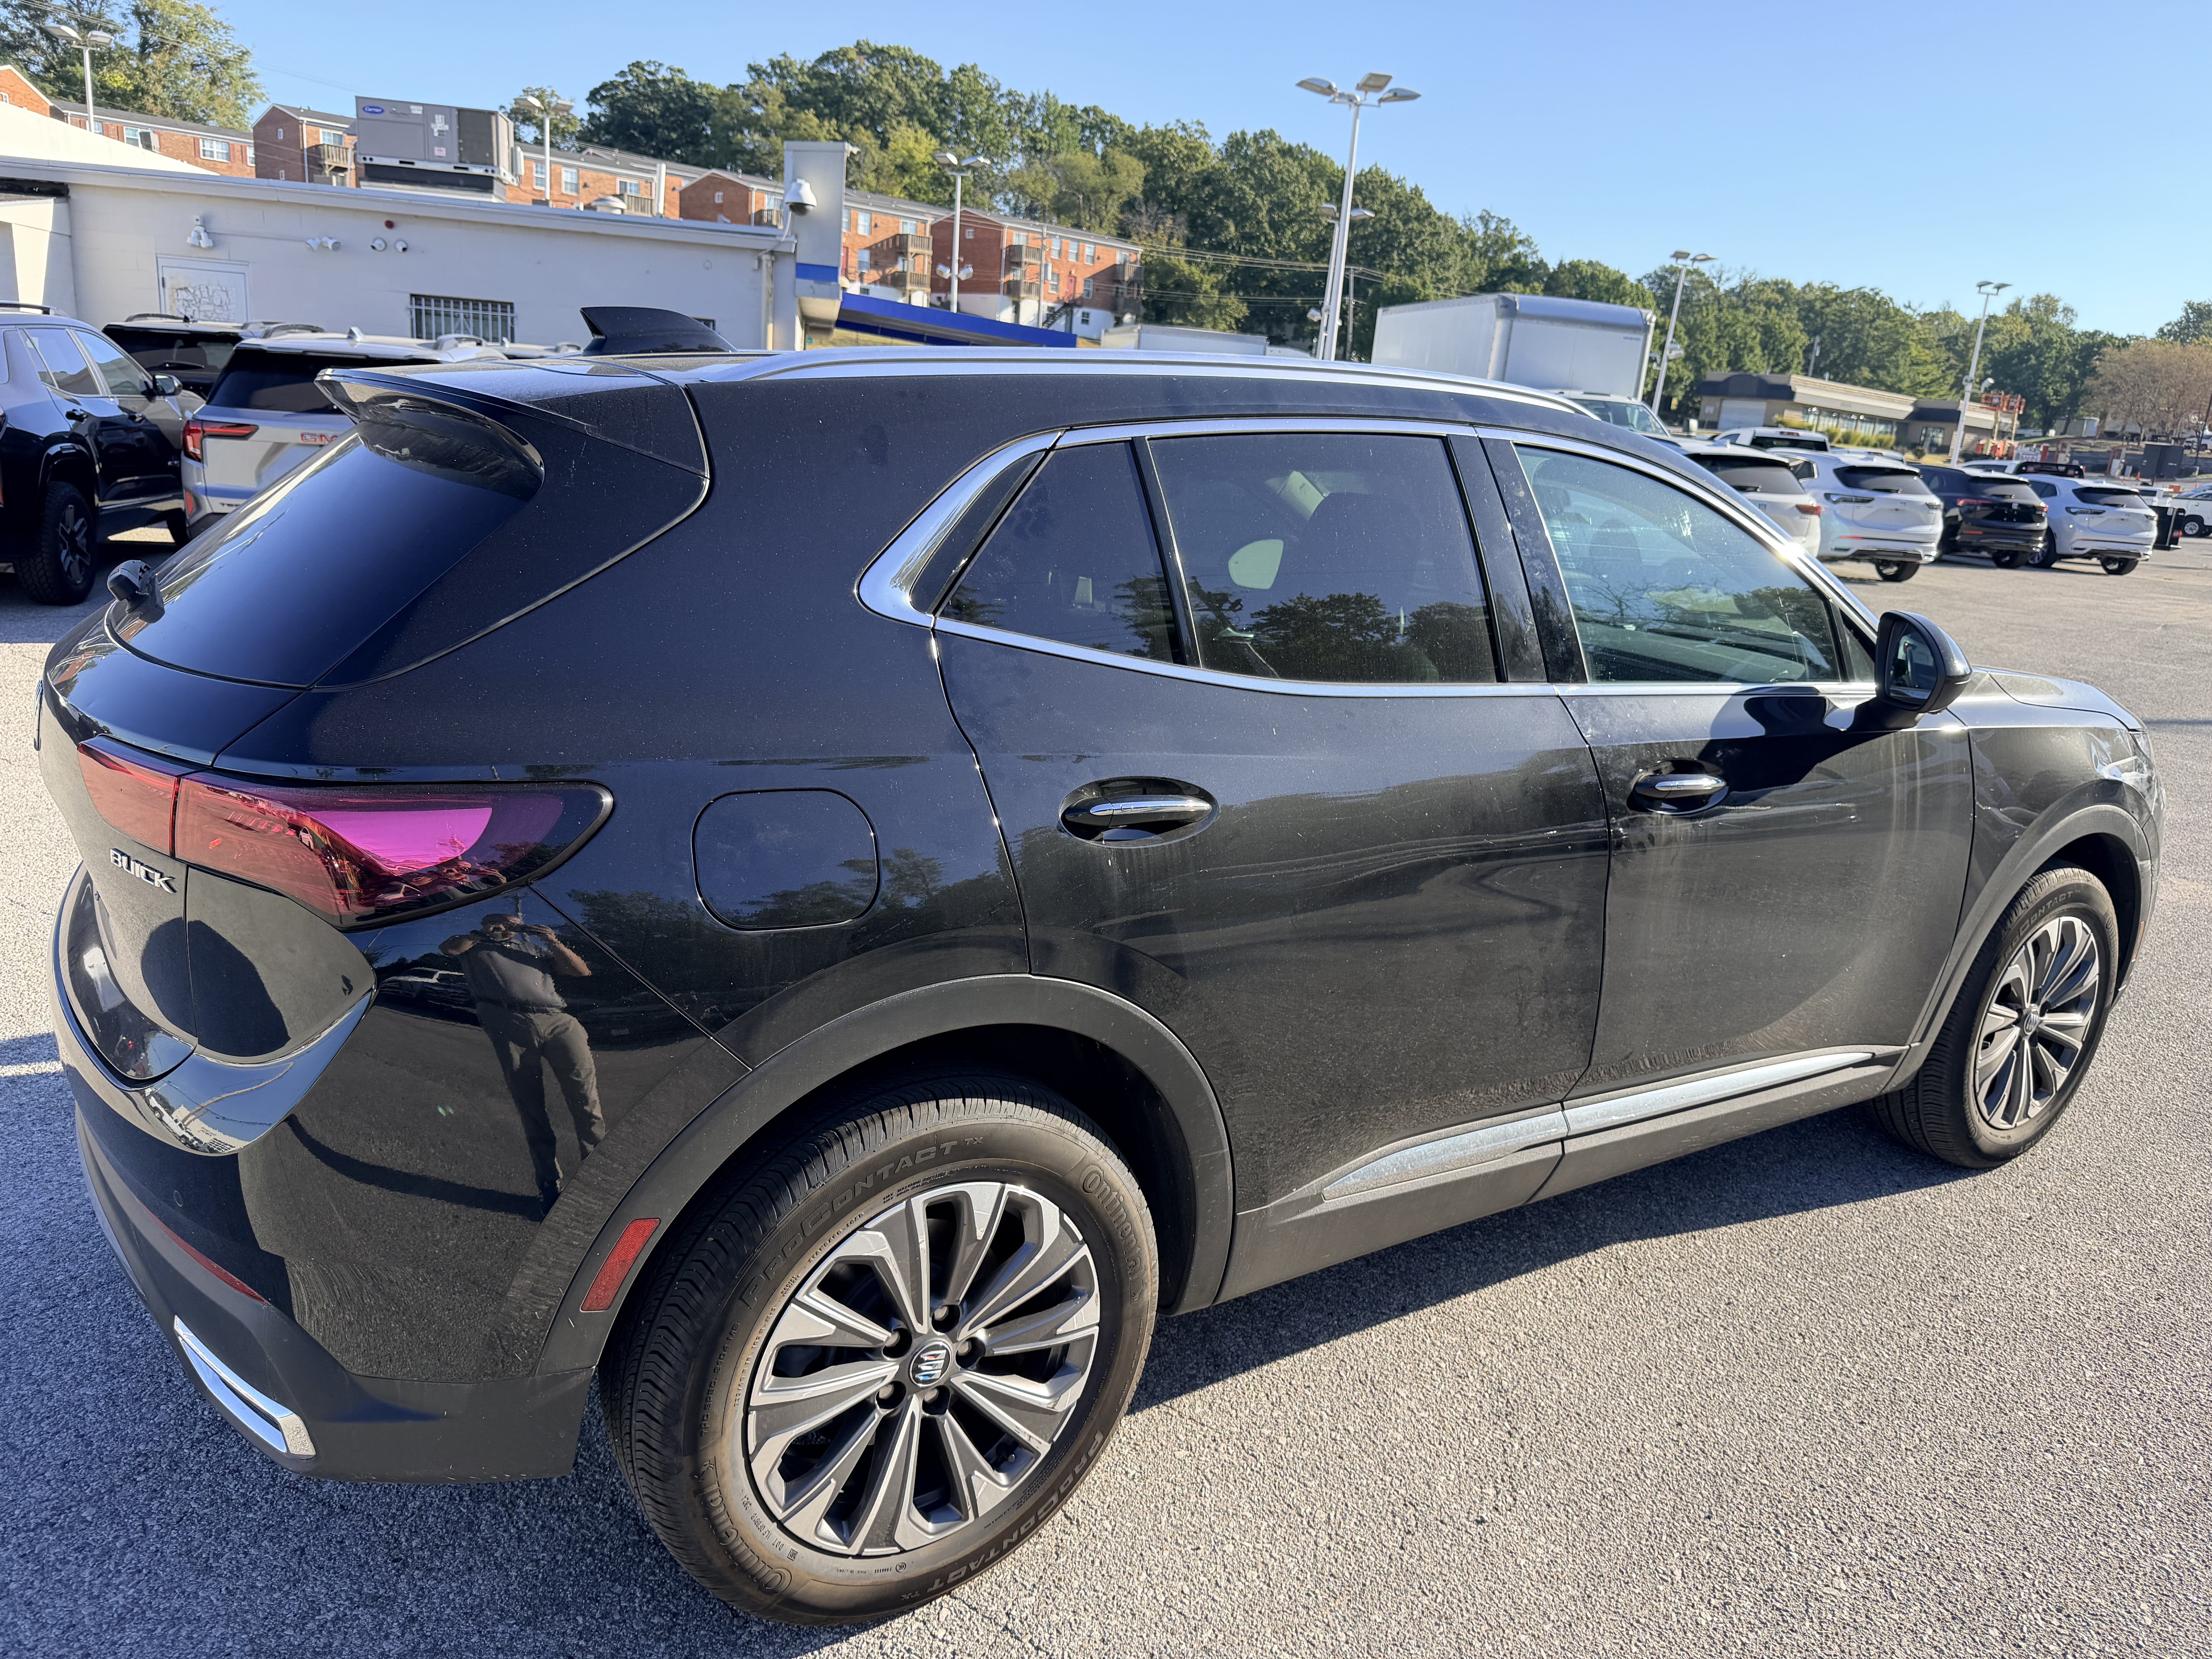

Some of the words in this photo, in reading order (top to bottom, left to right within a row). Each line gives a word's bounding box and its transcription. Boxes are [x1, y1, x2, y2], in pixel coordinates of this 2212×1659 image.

[110, 848, 177, 893] BUICK
[738, 1140, 958, 1309] PROCONTACT
[964, 1137, 983, 1146] TX
[1079, 1164, 1146, 1281] Continental
[772, 1538, 784, 1551] DOT
